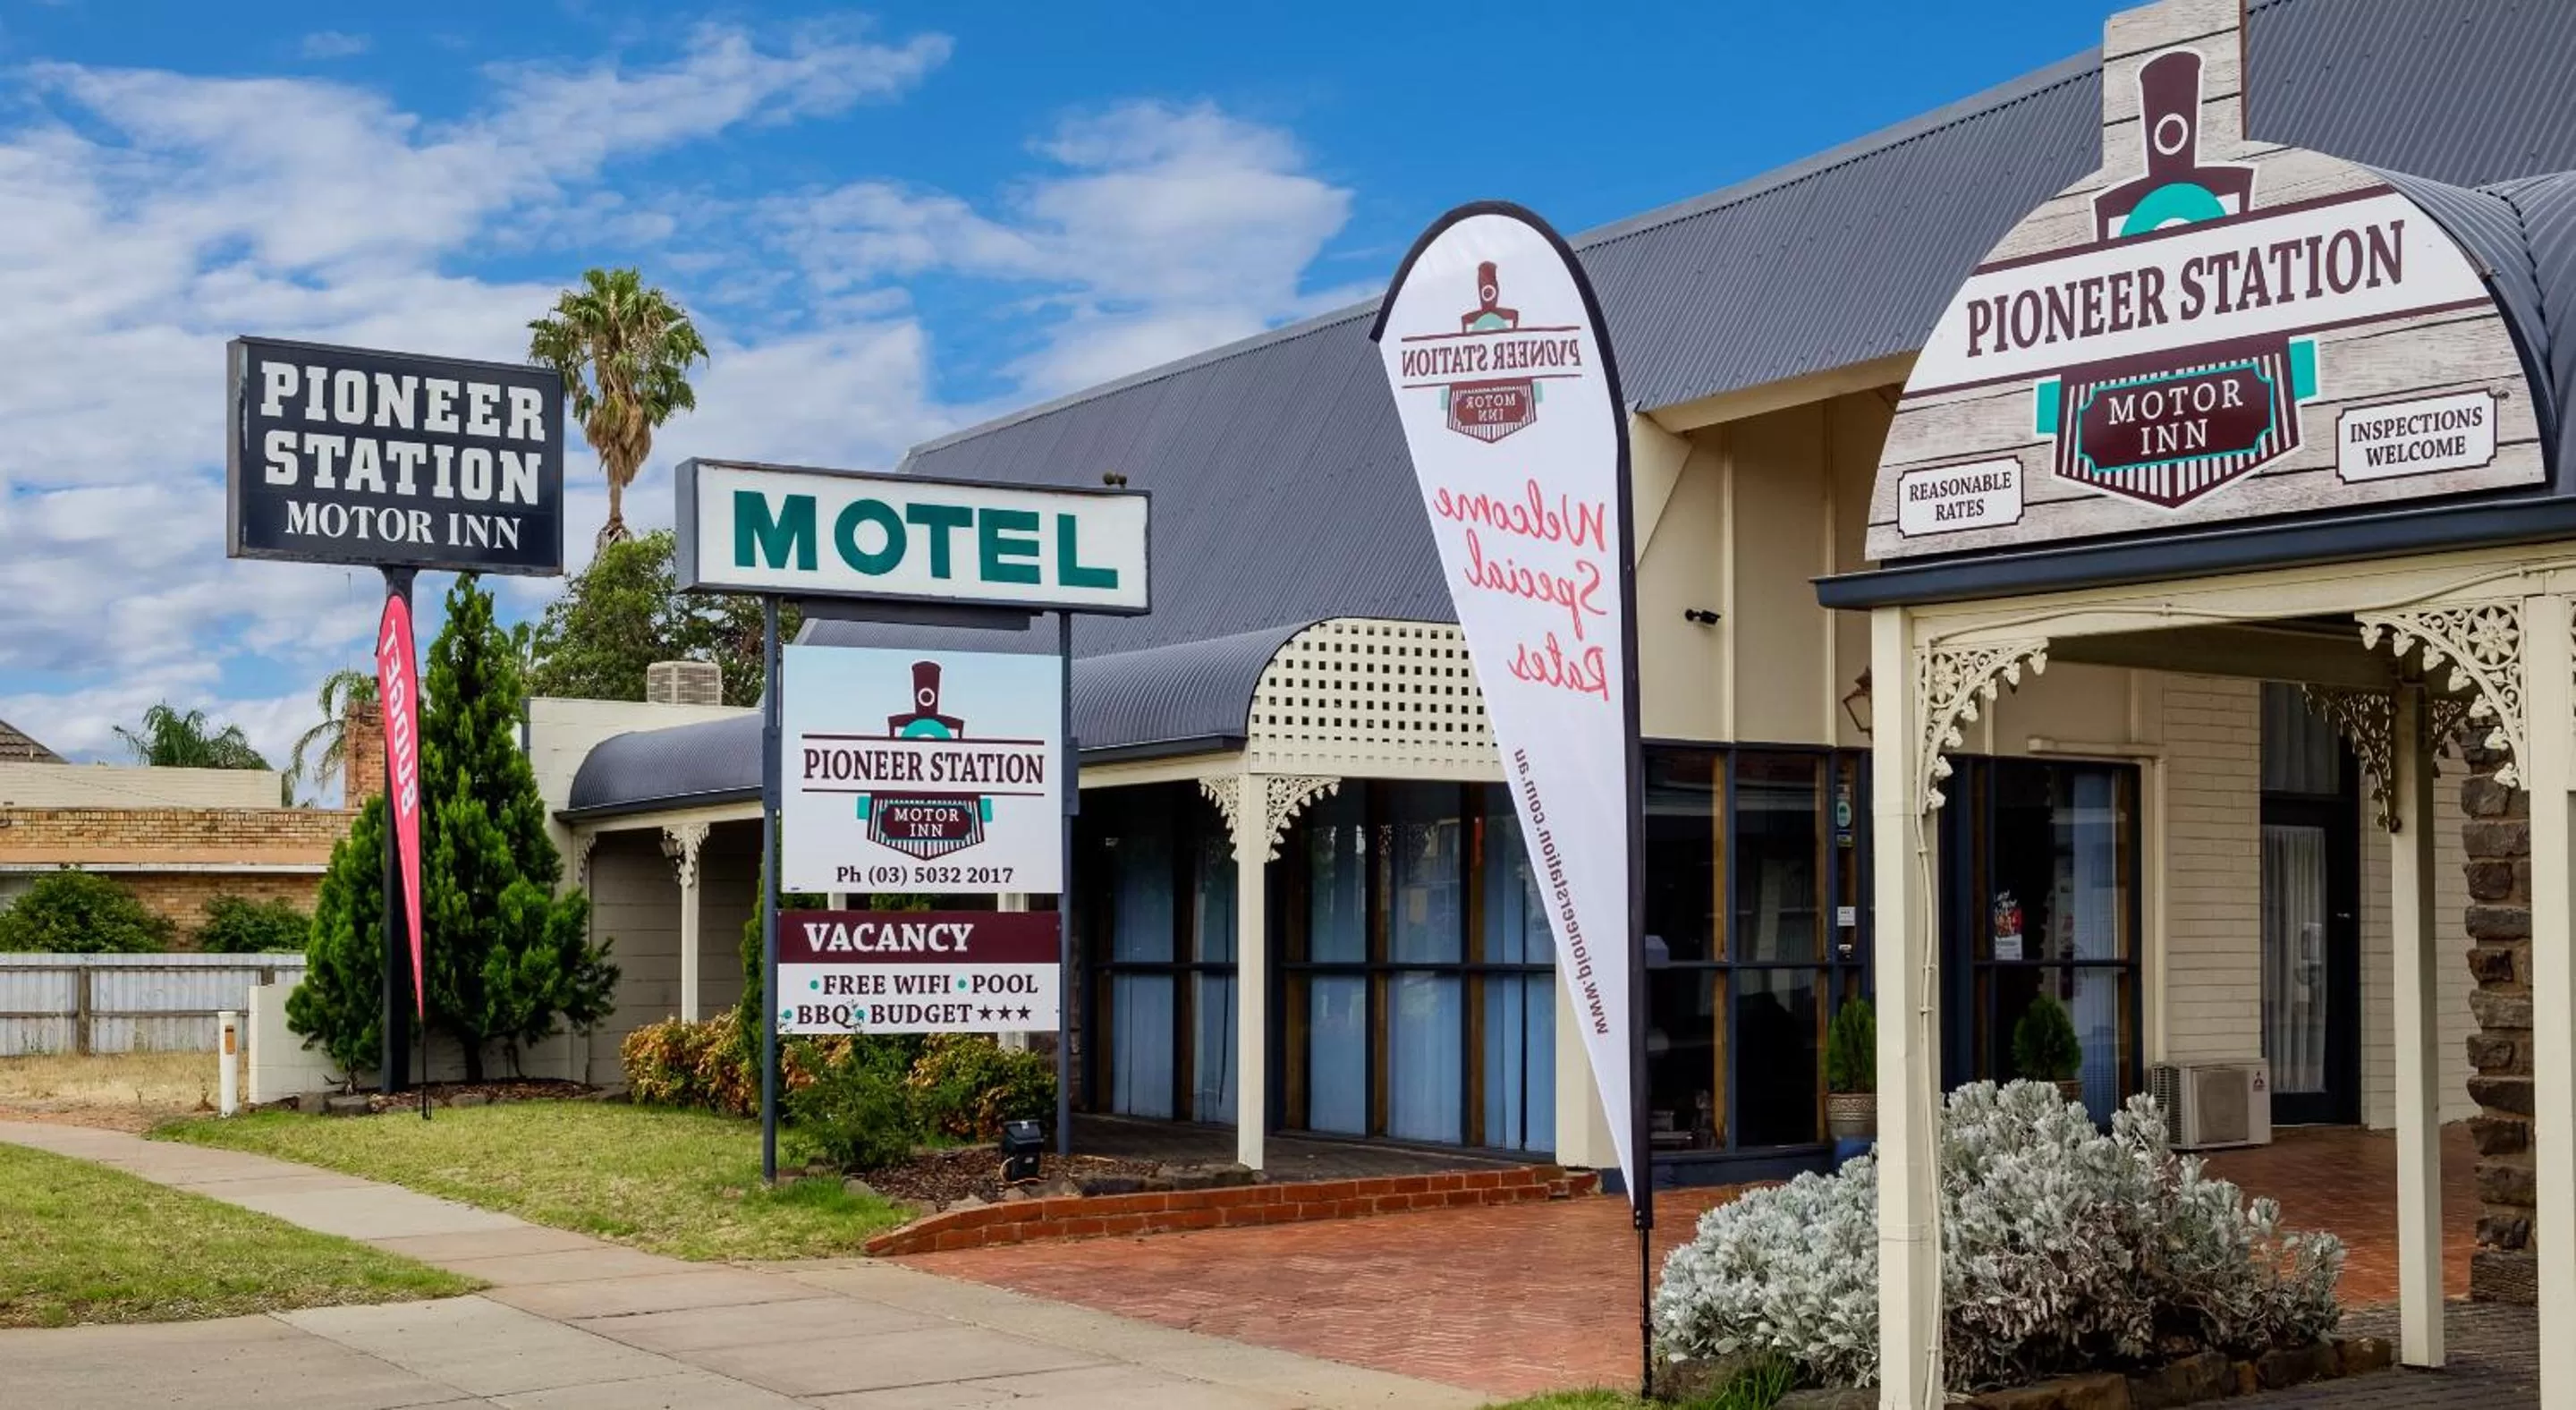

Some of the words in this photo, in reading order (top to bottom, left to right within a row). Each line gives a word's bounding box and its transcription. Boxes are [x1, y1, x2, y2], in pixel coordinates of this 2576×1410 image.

[1967, 266, 2166, 357] PIONEER
[2180, 220, 2405, 319] STATION
[260, 361, 546, 442] PIONEER
[2108, 379, 2243, 425] MOTOR
[2140, 419, 2207, 455] INN
[2351, 406, 2482, 443] INSPECTIONS
[265, 429, 541, 505] STATION
[2366, 436, 2466, 467] WELCOME
[1909, 471, 2012, 501] REASONABLE
[284, 500, 434, 544] MOTOR
[447, 513, 521, 550] INN
[1936, 499, 1985, 521] RATES
[733, 490, 1118, 589] MOTEL
[803, 748, 924, 781] PIONEER
[930, 752, 1045, 784] STATION
[894, 808, 959, 822] MOTOR
[910, 823, 943, 837] INN
[836, 866, 861, 883] Ph
[868, 866, 908, 885] (03)
[914, 867, 961, 884] 5032
[967, 867, 1013, 884] 2017
[803, 922, 974, 952] VACANCY
[823, 974, 886, 995] FREE
[894, 974, 950, 995] WIFI
[971, 974, 1038, 994] POOL
[797, 1004, 857, 1028] BBQ
[870, 1004, 972, 1024] BUDGET
